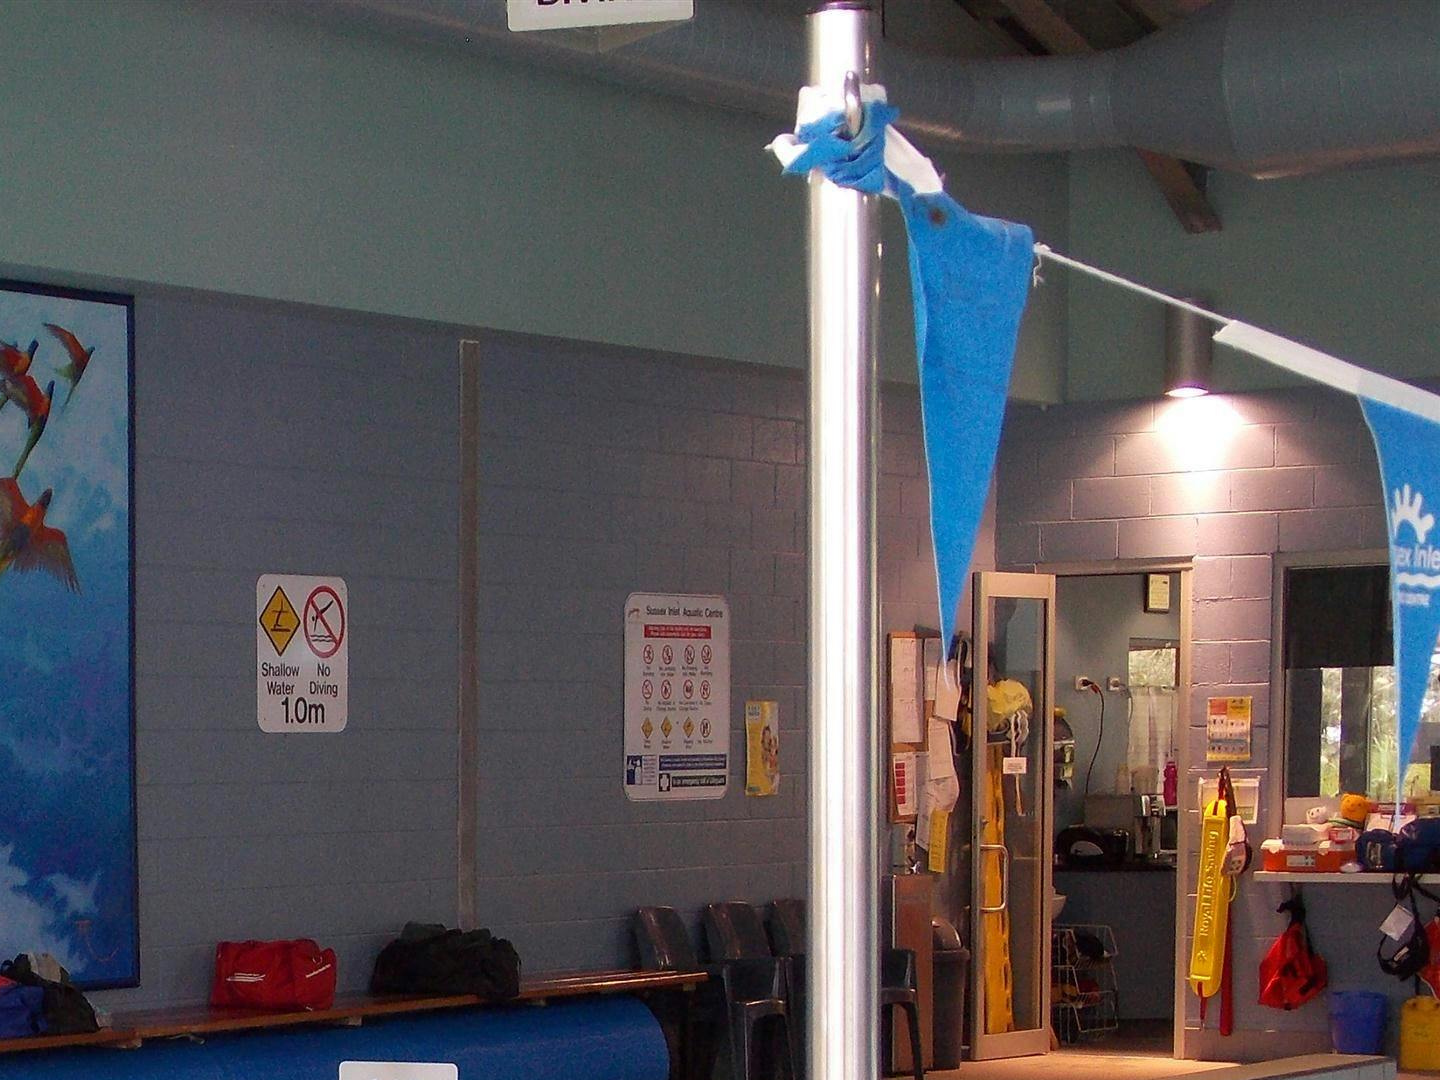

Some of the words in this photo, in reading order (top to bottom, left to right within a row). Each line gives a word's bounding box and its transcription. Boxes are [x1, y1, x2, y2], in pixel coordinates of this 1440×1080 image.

[261, 662, 300, 677] Shallow
[317, 664, 331, 677] No
[267, 681, 295, 695] Water
[309, 681, 338, 697] Diving
[281, 697, 325, 724] 1.0m
[1199, 902, 1213, 936] Royal
